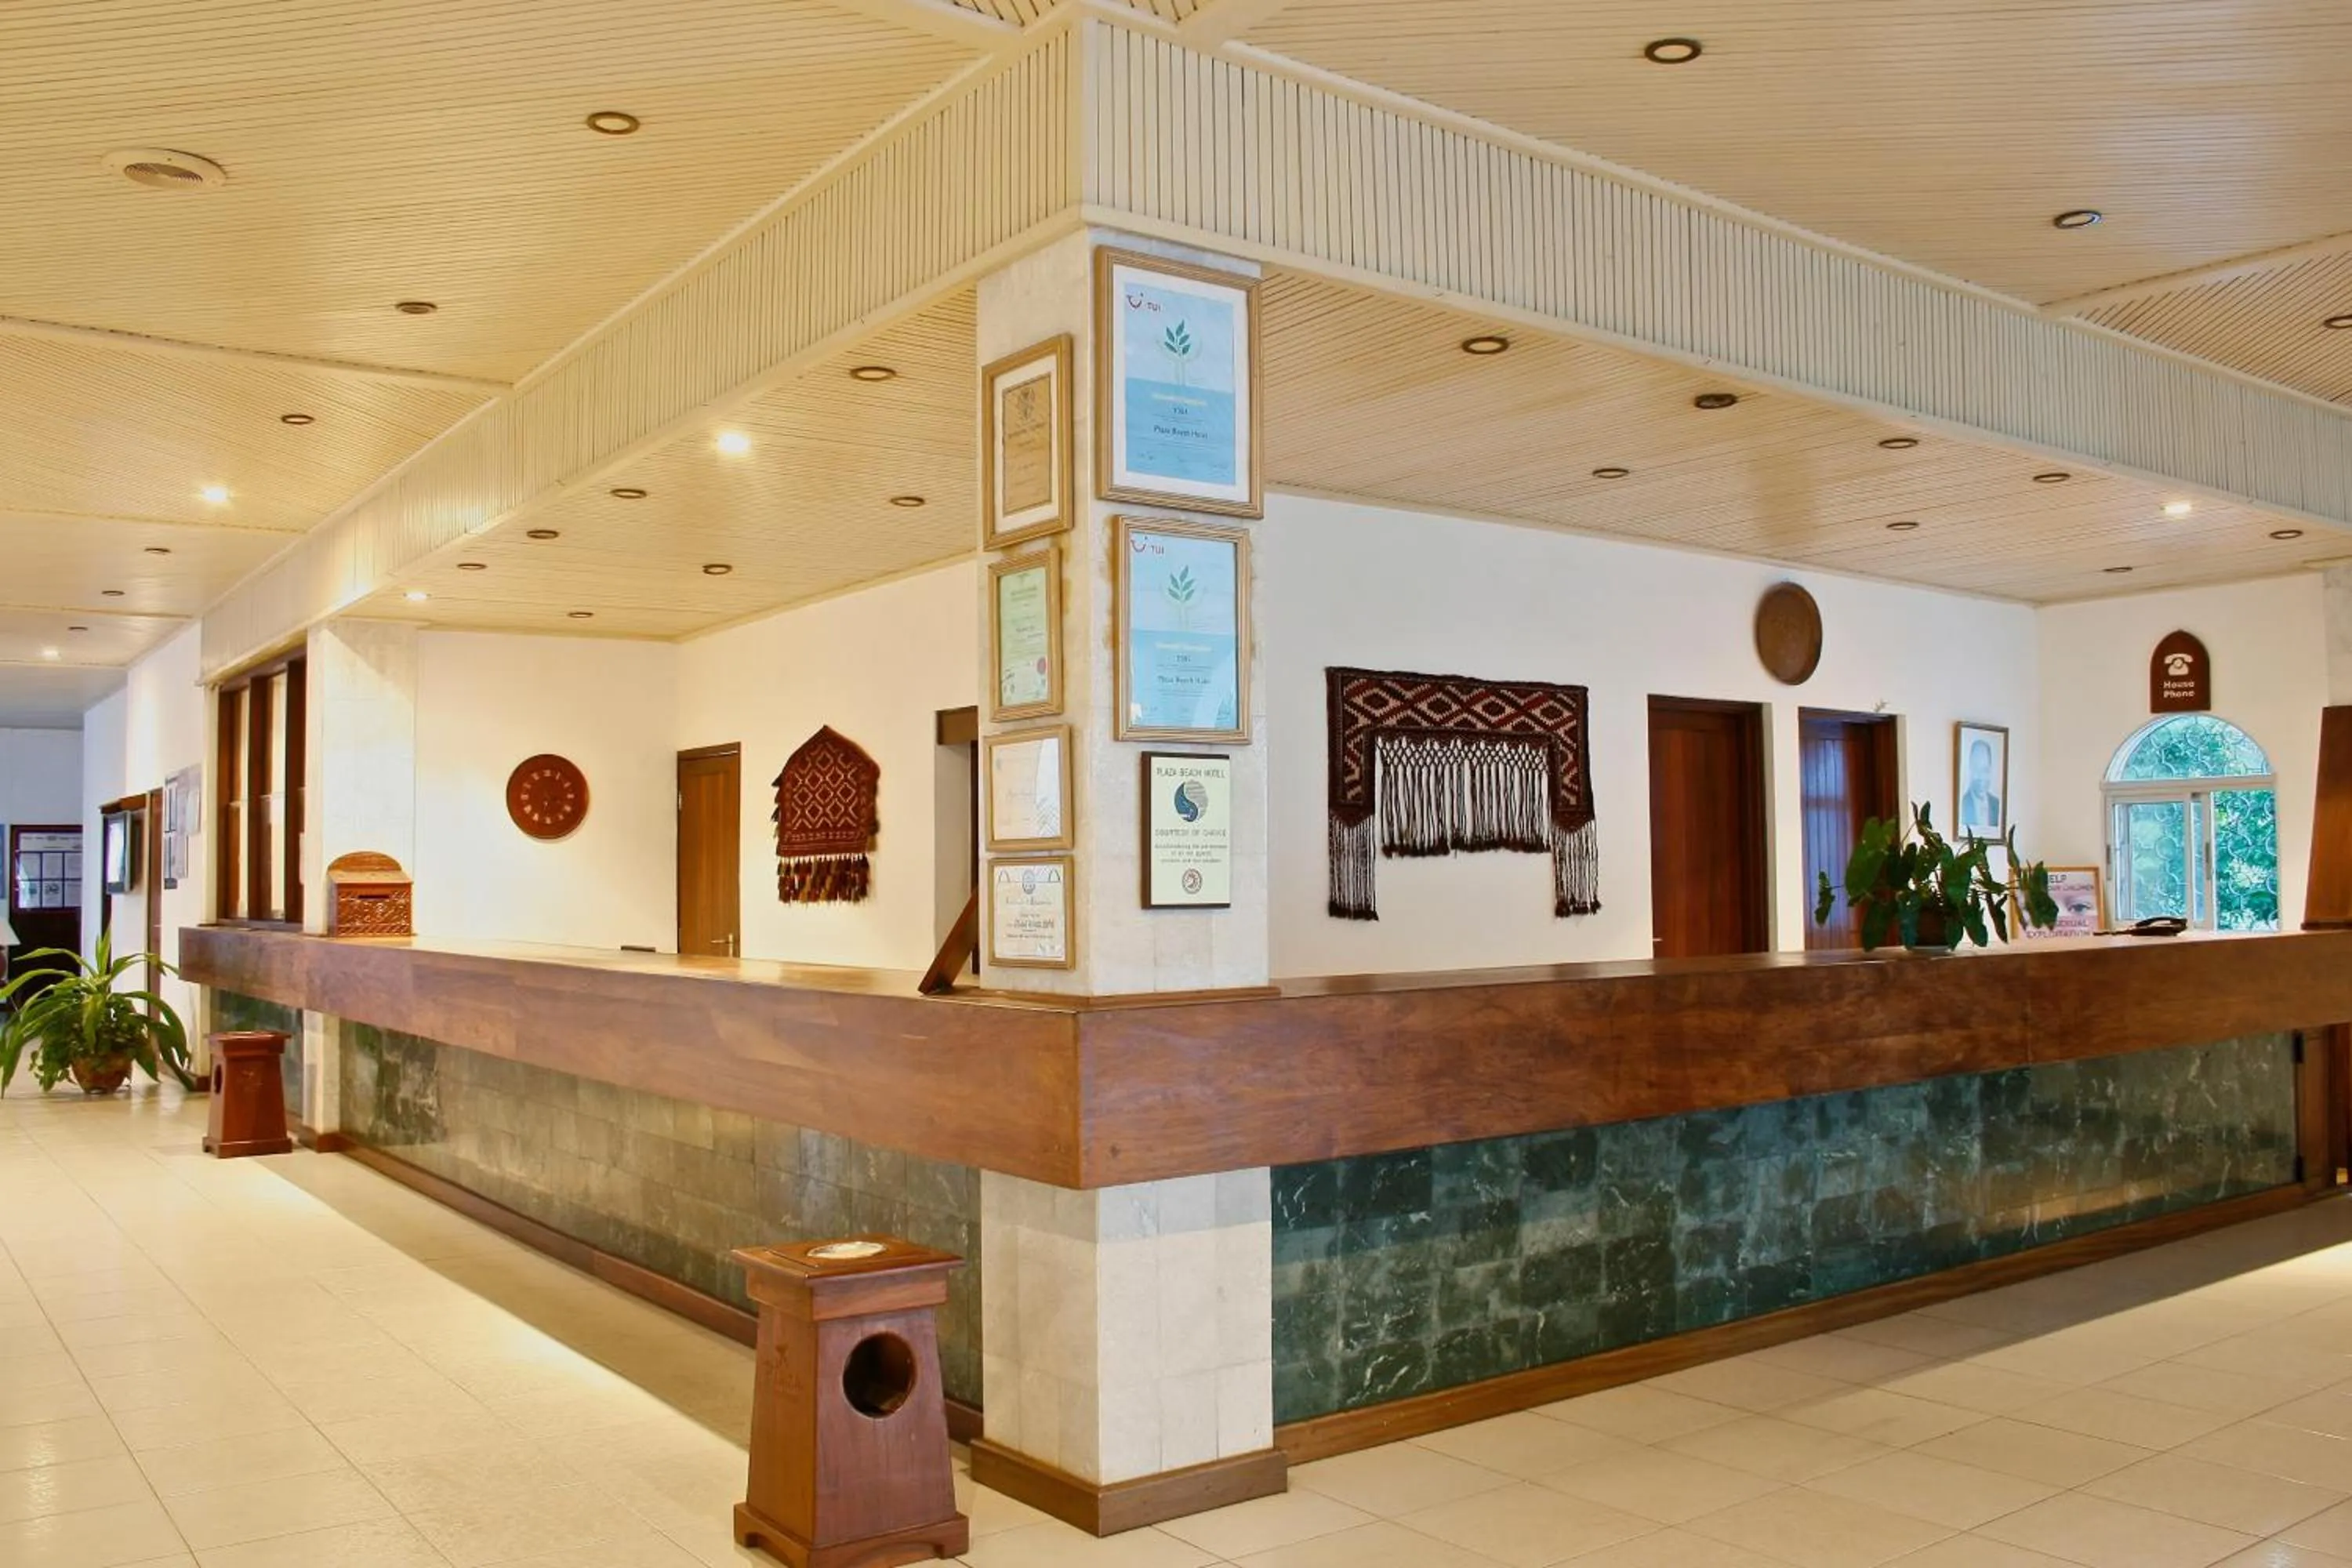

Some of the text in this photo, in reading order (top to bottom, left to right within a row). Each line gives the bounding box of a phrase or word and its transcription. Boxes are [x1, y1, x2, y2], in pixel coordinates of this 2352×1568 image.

[1148, 302, 1161, 312] TUI
[1151, 545, 1164, 554] TUI
[2163, 681, 2195, 689] House
[2163, 690, 2196, 699] Phone
[1179, 768, 1201, 778] BEACH
[2049, 874, 2067, 884] ELP
